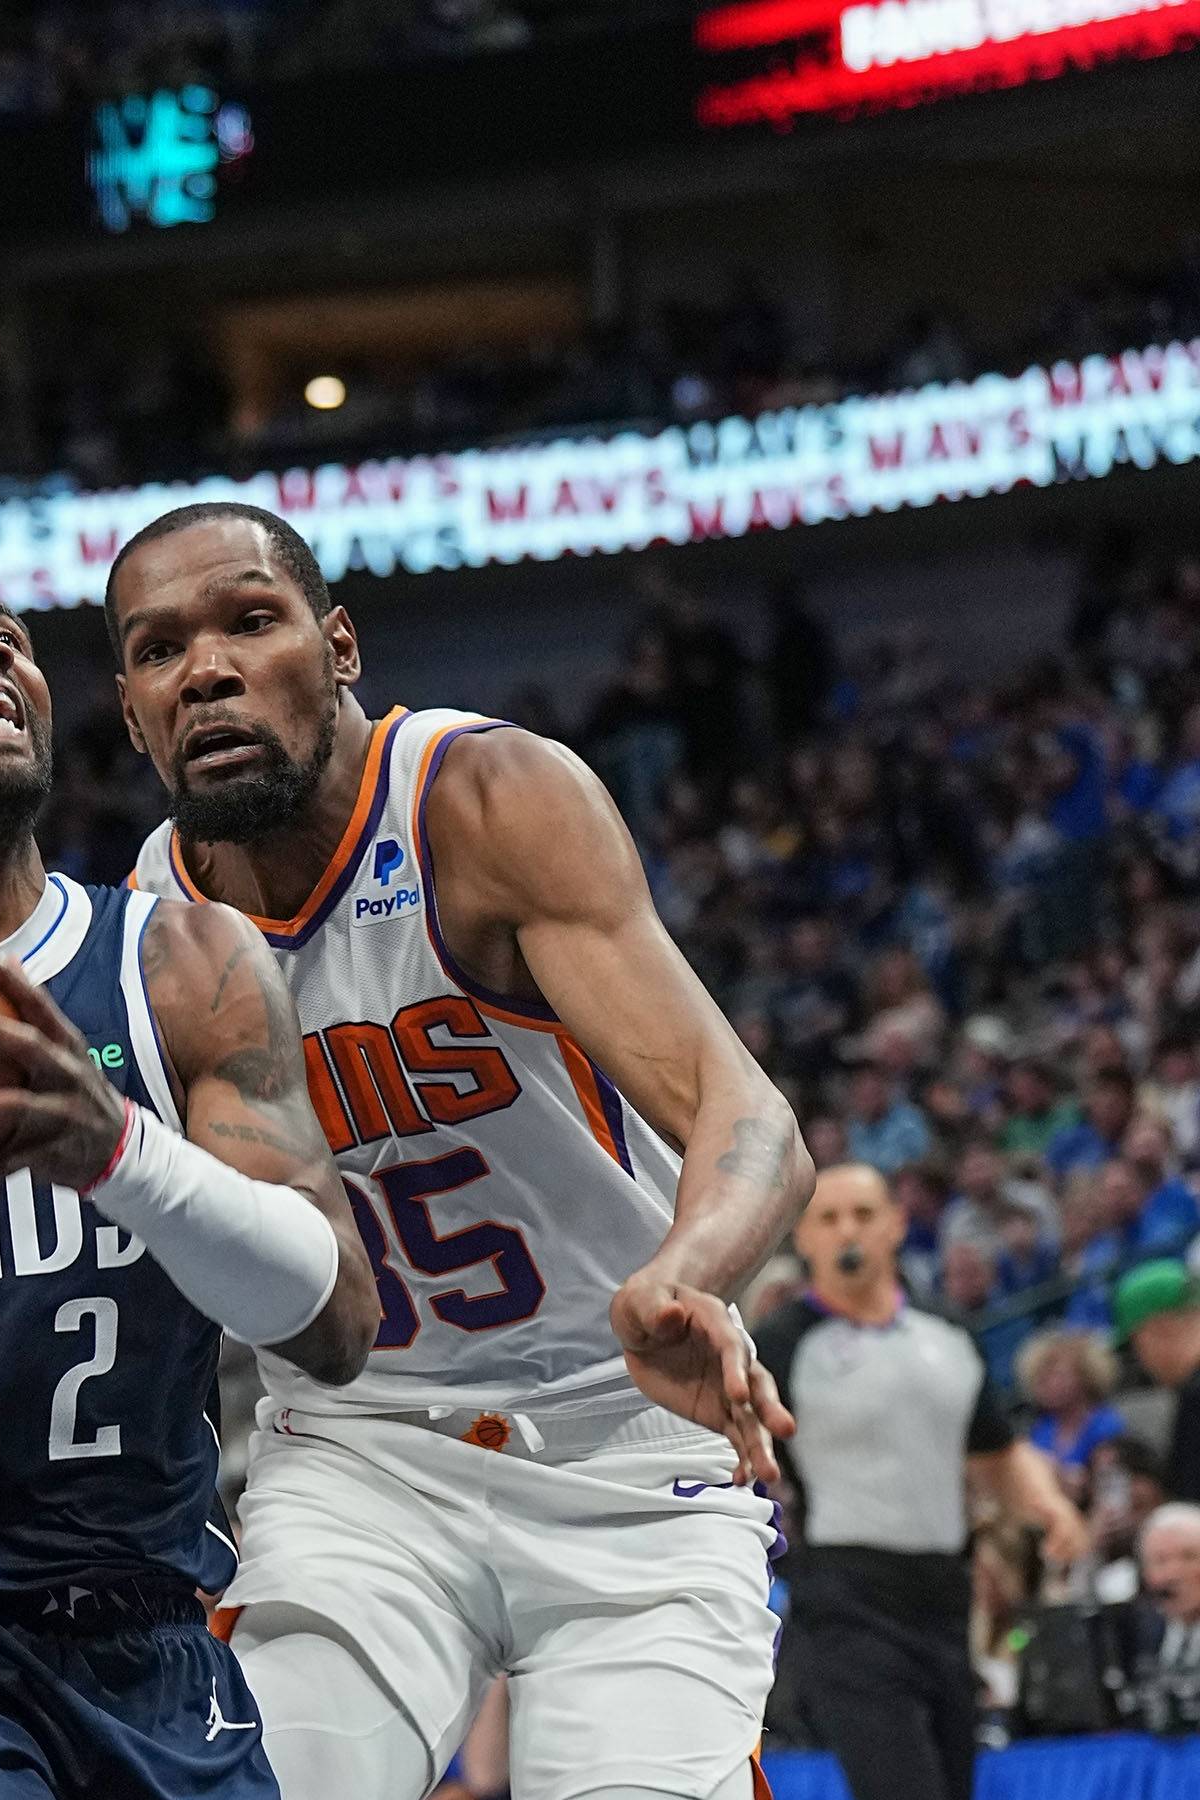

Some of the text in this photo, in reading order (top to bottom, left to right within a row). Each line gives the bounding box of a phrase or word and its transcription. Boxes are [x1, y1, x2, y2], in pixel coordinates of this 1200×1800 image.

[870, 407, 1031, 471] MAVS
[487, 468, 667, 521] MAVS
[356, 883, 420, 919] PayPal
[302, 994, 523, 1155] NS
[48, 1296, 122, 1462] 2
